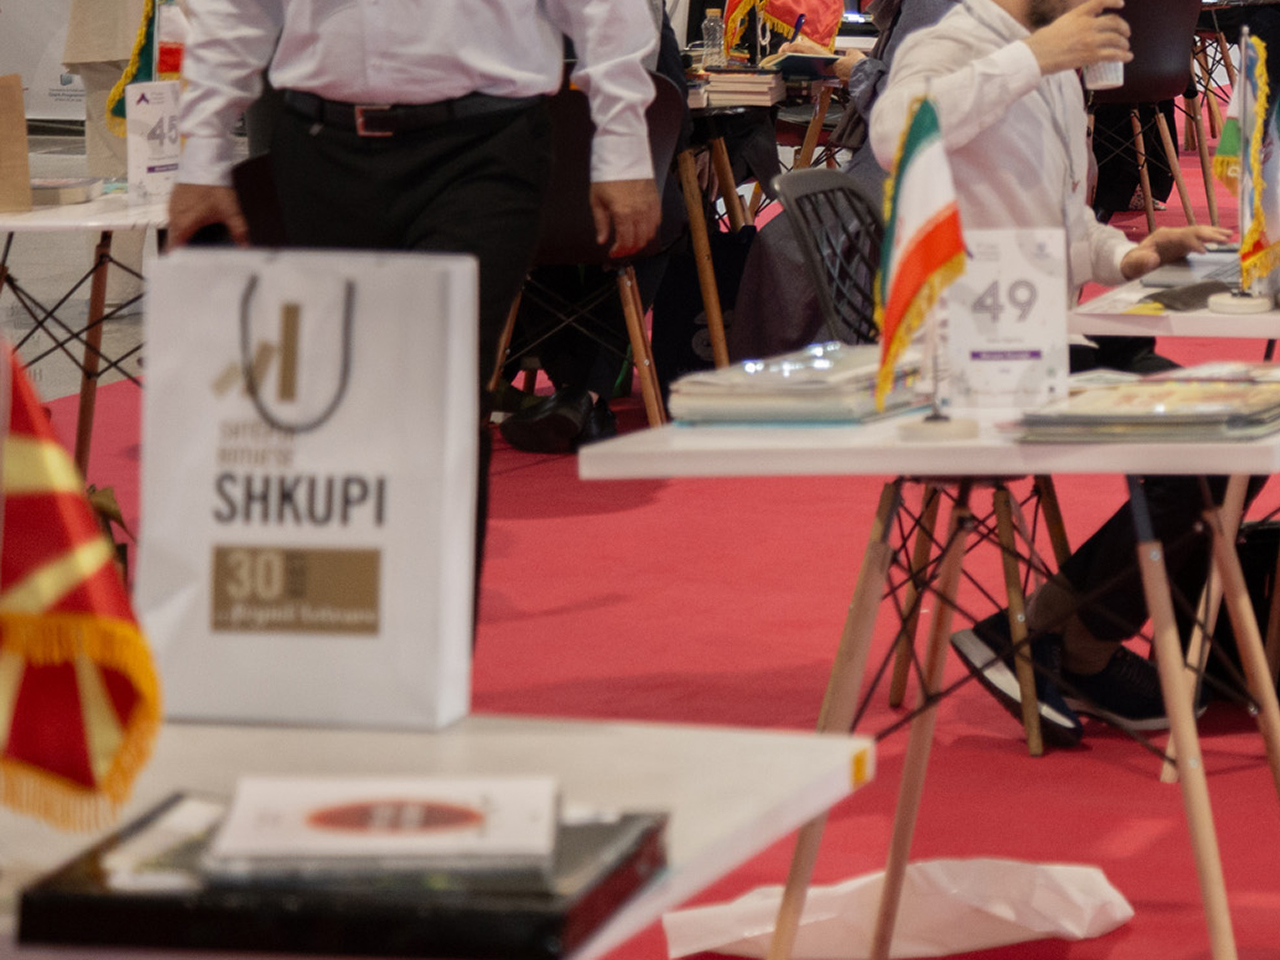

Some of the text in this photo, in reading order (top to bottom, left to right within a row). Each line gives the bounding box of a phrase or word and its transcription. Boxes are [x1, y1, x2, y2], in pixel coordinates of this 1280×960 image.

[972, 279, 1038, 323] 49
[213, 472, 387, 528] SHKUPI
[226, 550, 285, 602] 30
